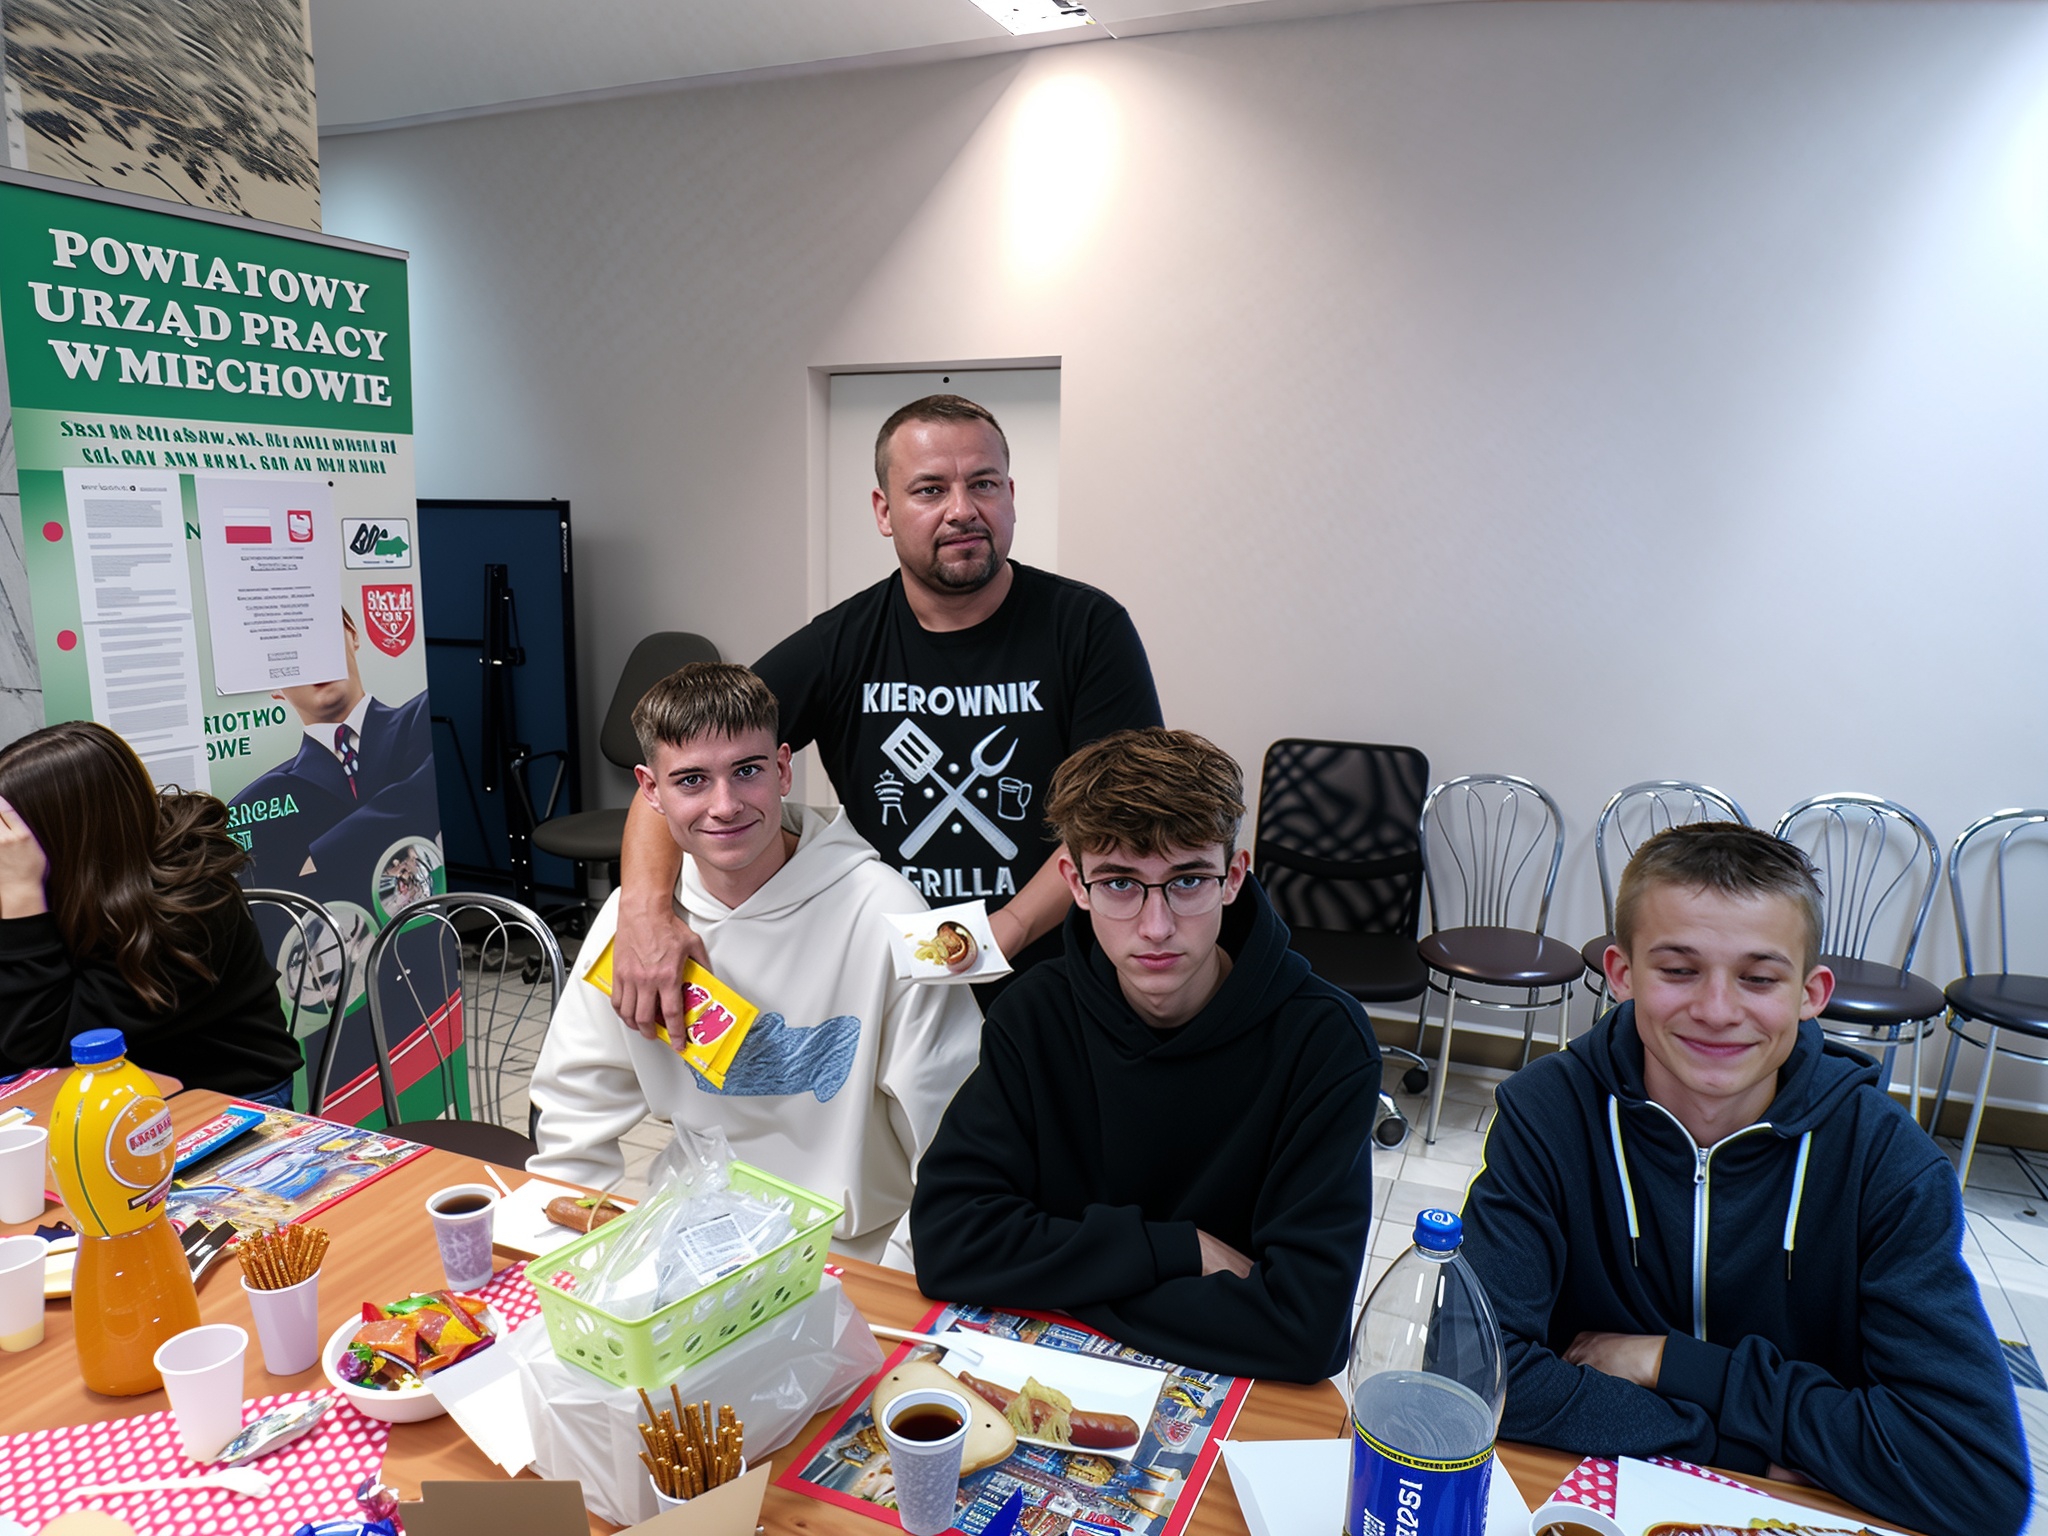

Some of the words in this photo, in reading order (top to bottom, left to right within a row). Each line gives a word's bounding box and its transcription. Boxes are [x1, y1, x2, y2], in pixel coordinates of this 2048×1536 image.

[48, 227, 370, 314] POWIATOWY
[27, 281, 232, 347] URZĄD
[239, 311, 388, 362] PRACY
[47, 339, 110, 381] W
[115, 346, 393, 407] MIECHOWIE
[862, 680, 1043, 716] KIEROWNIK
